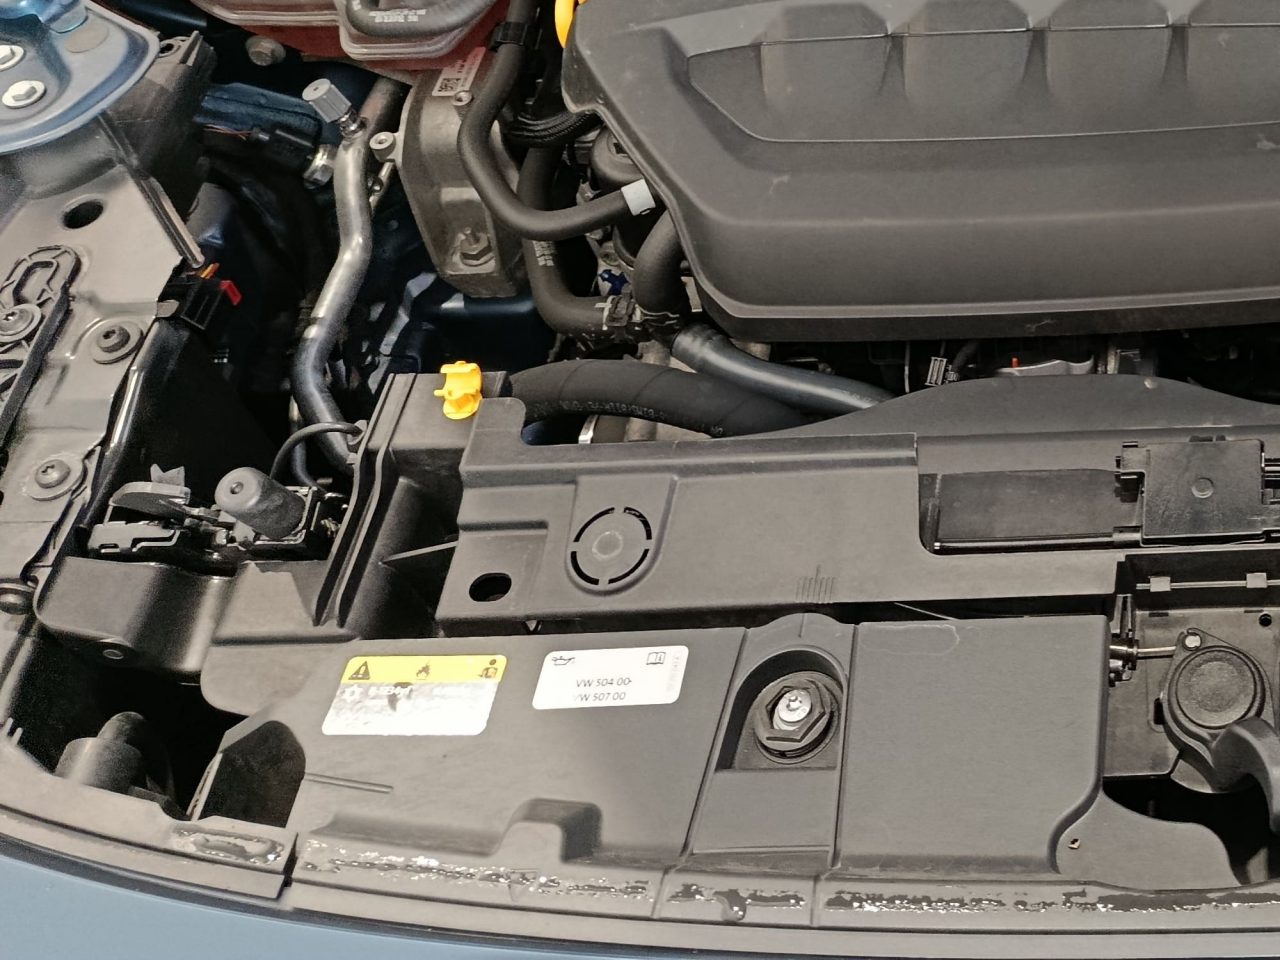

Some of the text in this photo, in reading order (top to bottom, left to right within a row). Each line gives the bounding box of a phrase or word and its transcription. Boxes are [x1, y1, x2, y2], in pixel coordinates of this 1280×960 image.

[576, 679, 593, 688] VW
[596, 678, 614, 687] 504
[612, 691, 626, 701] 00
